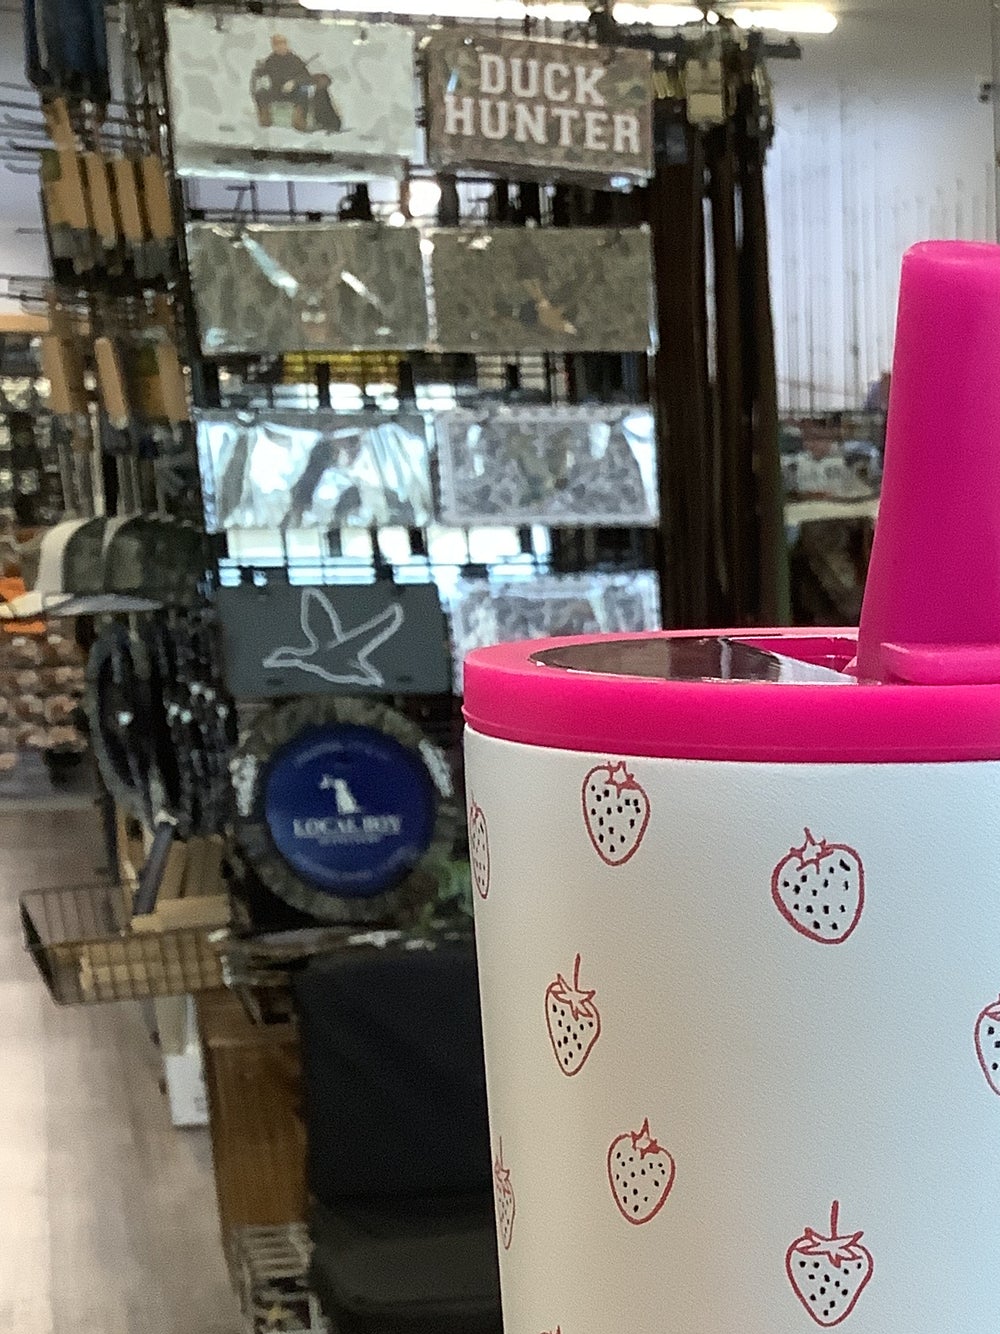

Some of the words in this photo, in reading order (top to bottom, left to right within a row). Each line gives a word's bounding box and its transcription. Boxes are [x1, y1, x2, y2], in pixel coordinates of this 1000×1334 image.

[478, 53, 607, 106] DUCK
[443, 94, 641, 154] HUNTER
[292, 816, 358, 839] LOCAL
